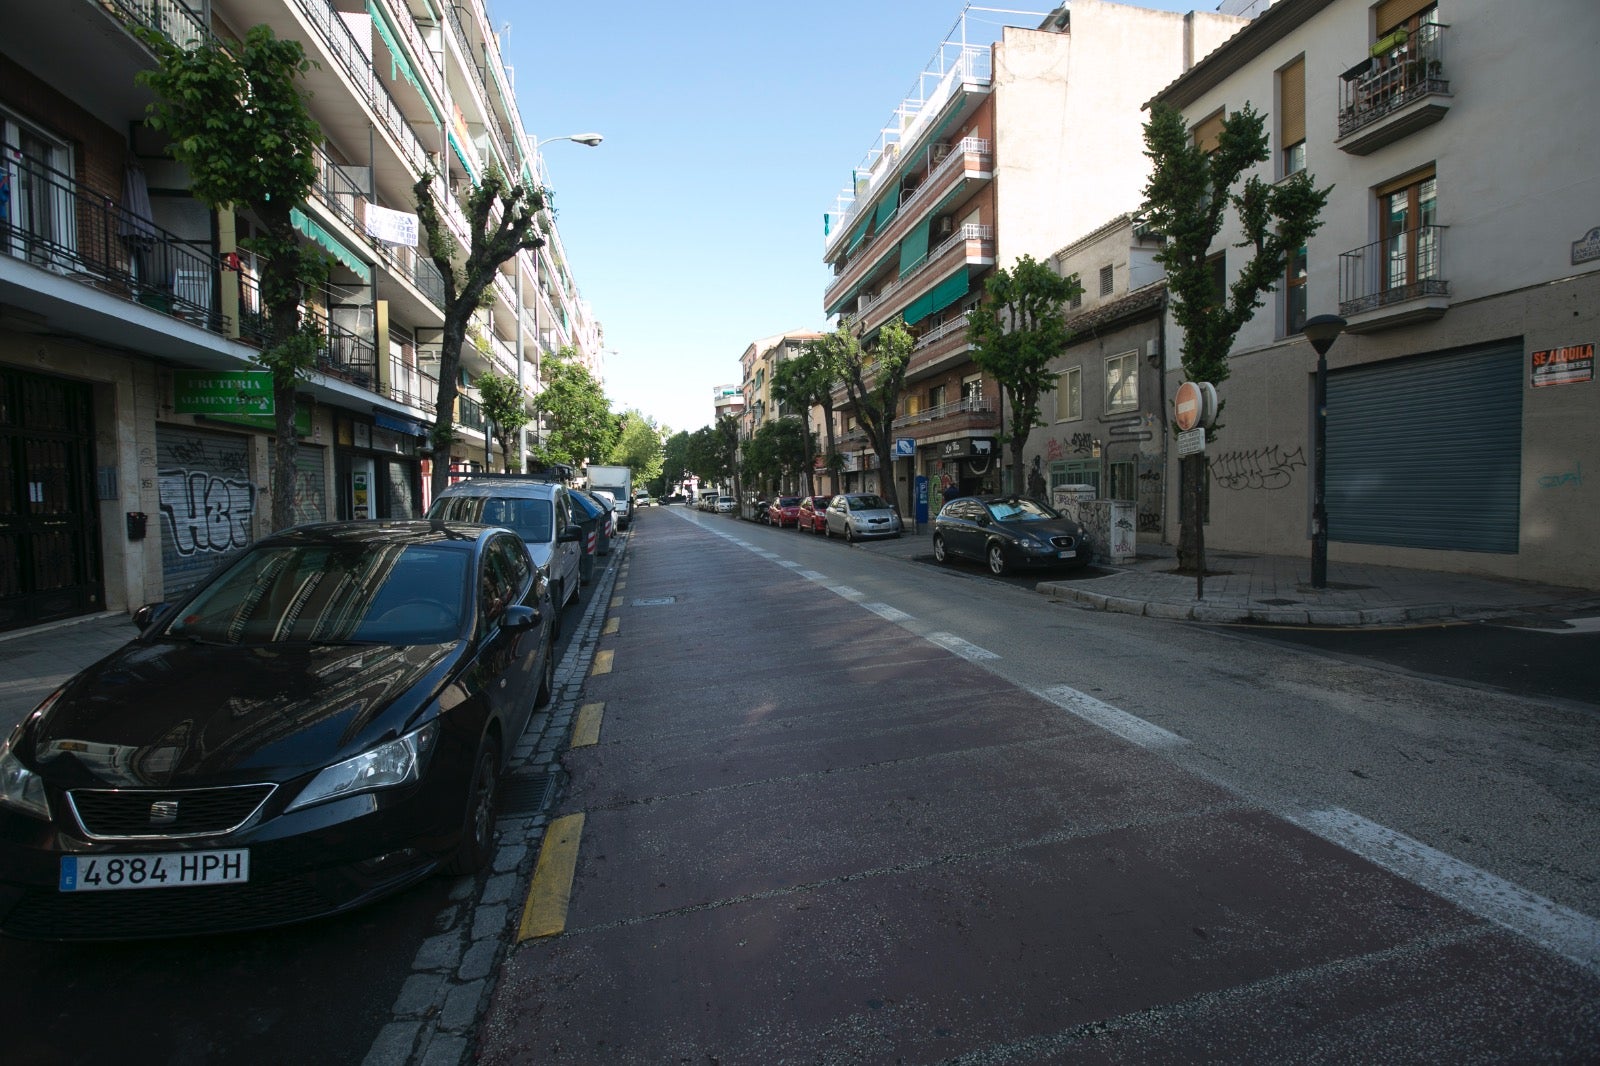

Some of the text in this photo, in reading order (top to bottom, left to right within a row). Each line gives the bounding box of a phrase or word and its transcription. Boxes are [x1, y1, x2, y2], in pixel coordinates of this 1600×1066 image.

[1533, 345, 1593, 367] SE ALQUILA
[83, 853, 241, 886] 4884 HPH
